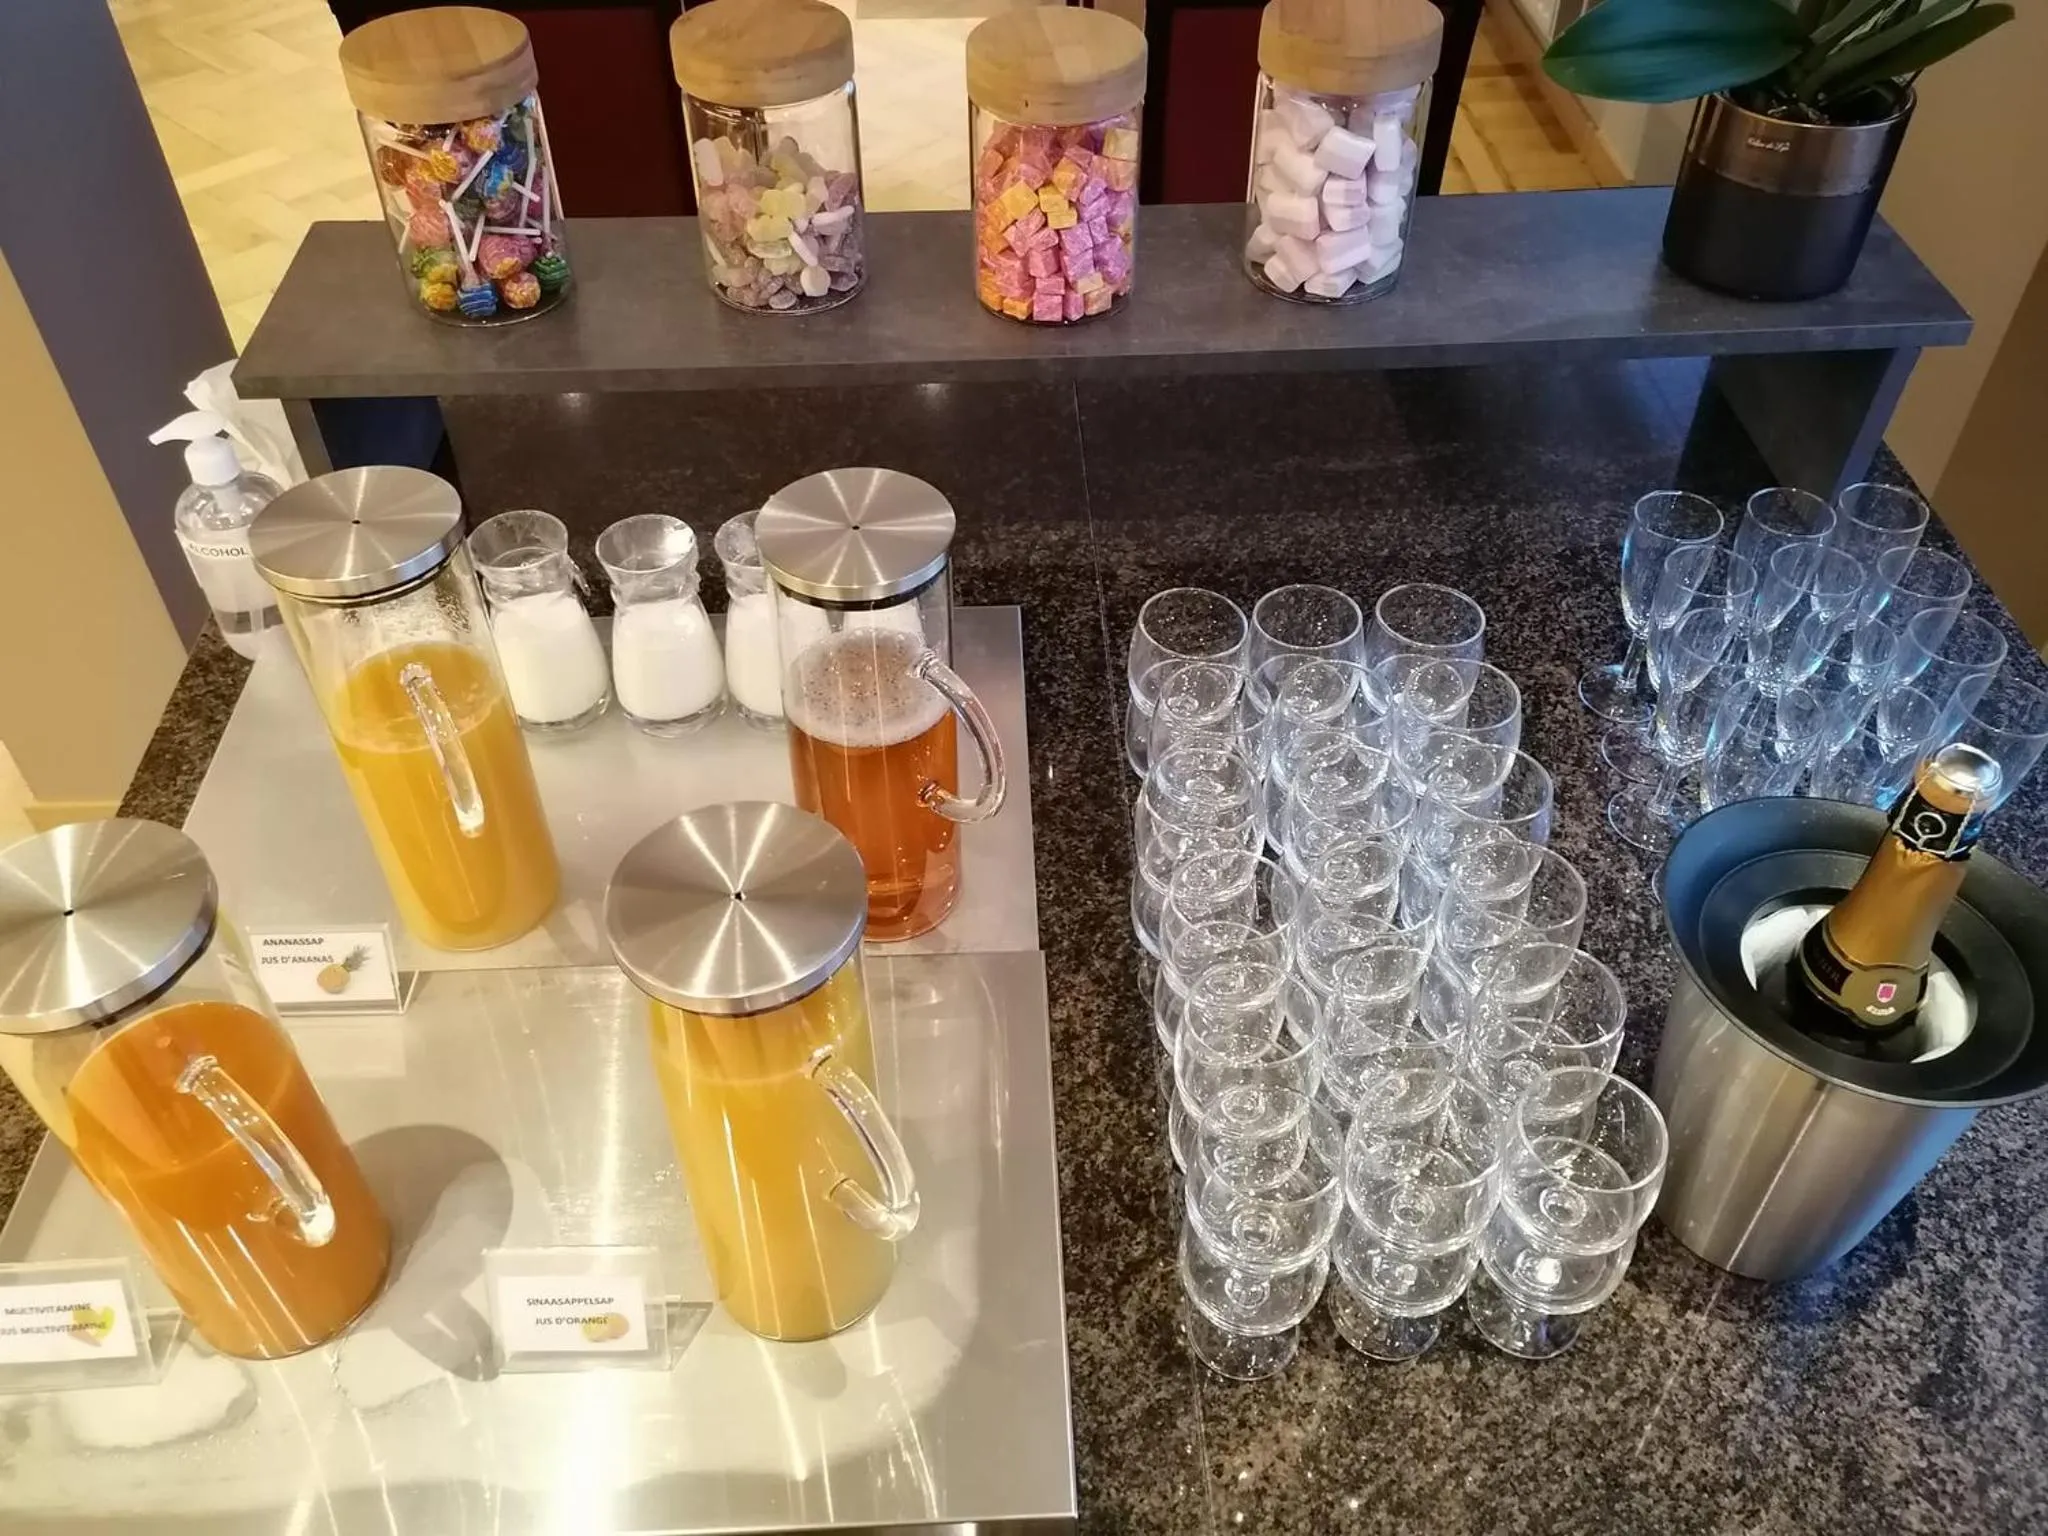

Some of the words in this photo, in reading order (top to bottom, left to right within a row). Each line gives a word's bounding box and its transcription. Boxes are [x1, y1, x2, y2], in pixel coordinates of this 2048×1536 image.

[263, 938, 324, 946] ANANASSAP
[261, 957, 278, 965] JUS
[281, 955, 334, 964] D'ANANAS
[526, 1297, 615, 1306] SINAASAPPELSAP
[4, 1303, 92, 1315] MULTIVITAMINE
[535, 1316, 553, 1325] JUS
[555, 1315, 609, 1325] D'ORANGE
[20, 1321, 107, 1334] MULTIVITAMINE
